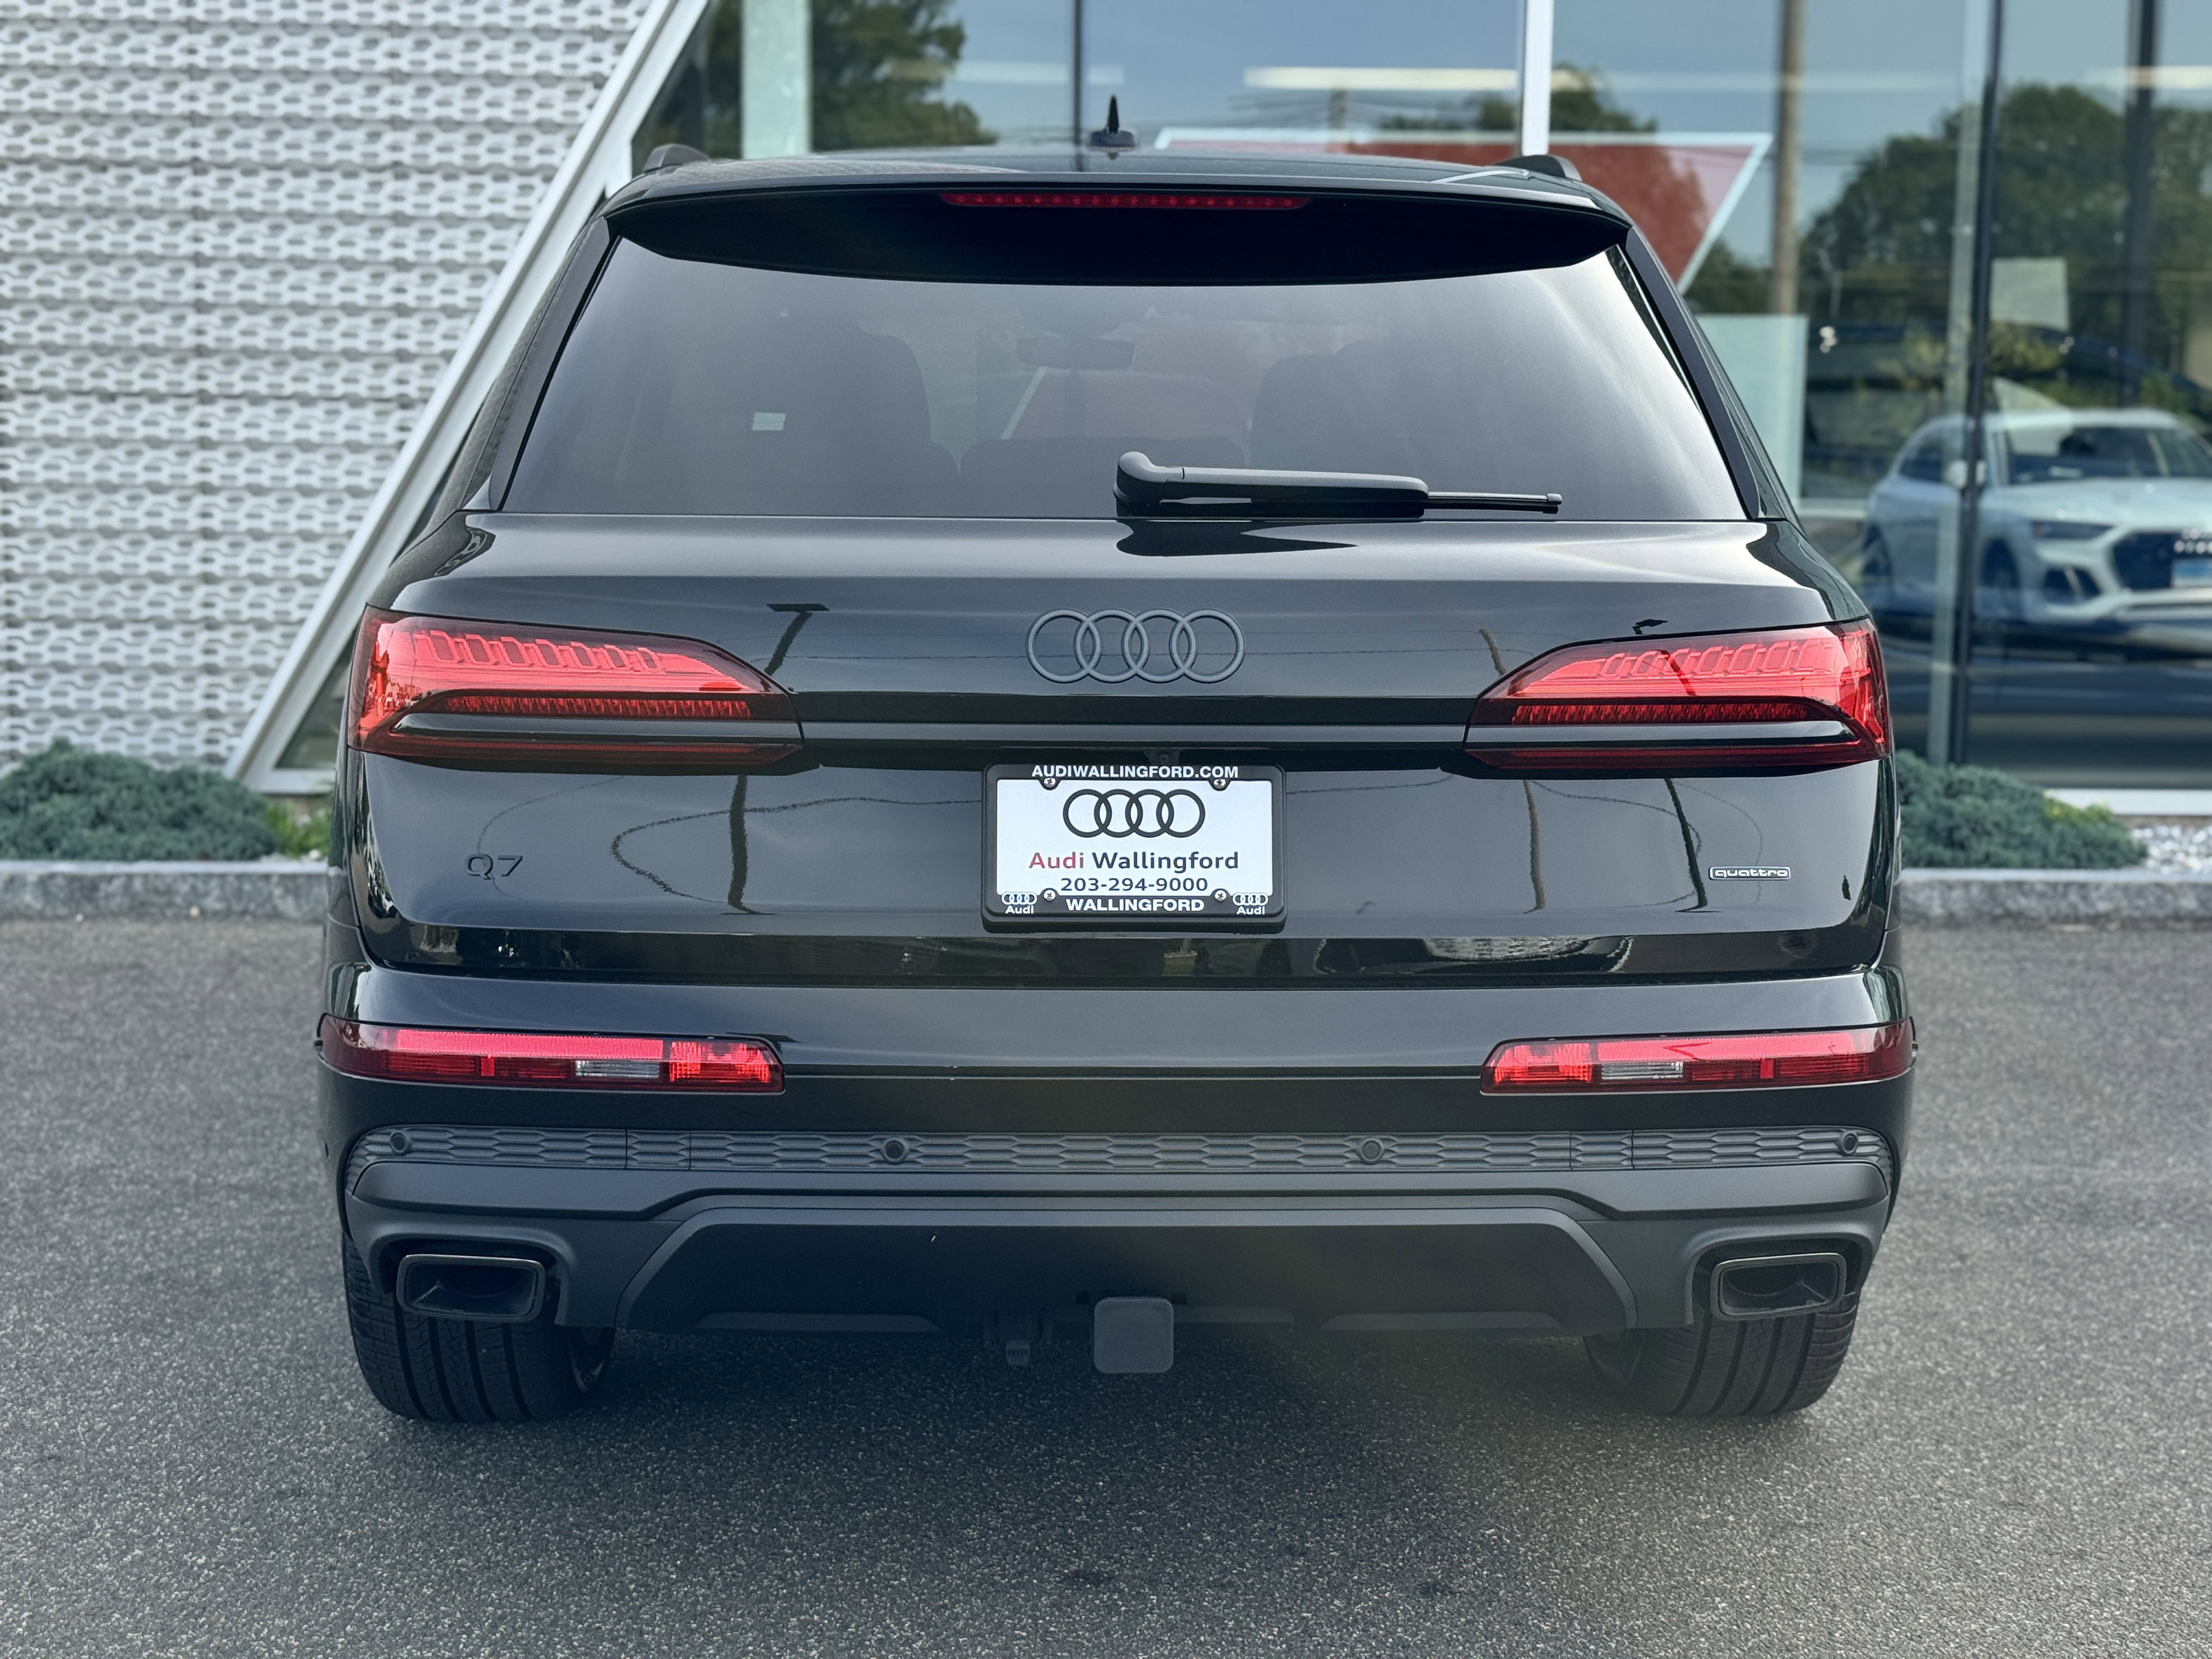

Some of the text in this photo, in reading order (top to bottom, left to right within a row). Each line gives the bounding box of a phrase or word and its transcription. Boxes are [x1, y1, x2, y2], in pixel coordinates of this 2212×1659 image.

[1031, 765, 1238, 778] AUDIWALLINGFORD.COM
[466, 854, 523, 879] Q7
[1029, 851, 1239, 873] Audi Wallingford
[1715, 868, 1787, 878] quattro
[1060, 877, 1208, 891] 203-294-9000
[1005, 905, 1034, 915] Audi
[1065, 898, 1204, 911] WALLINGFORD
[1236, 905, 1266, 915] Audi
